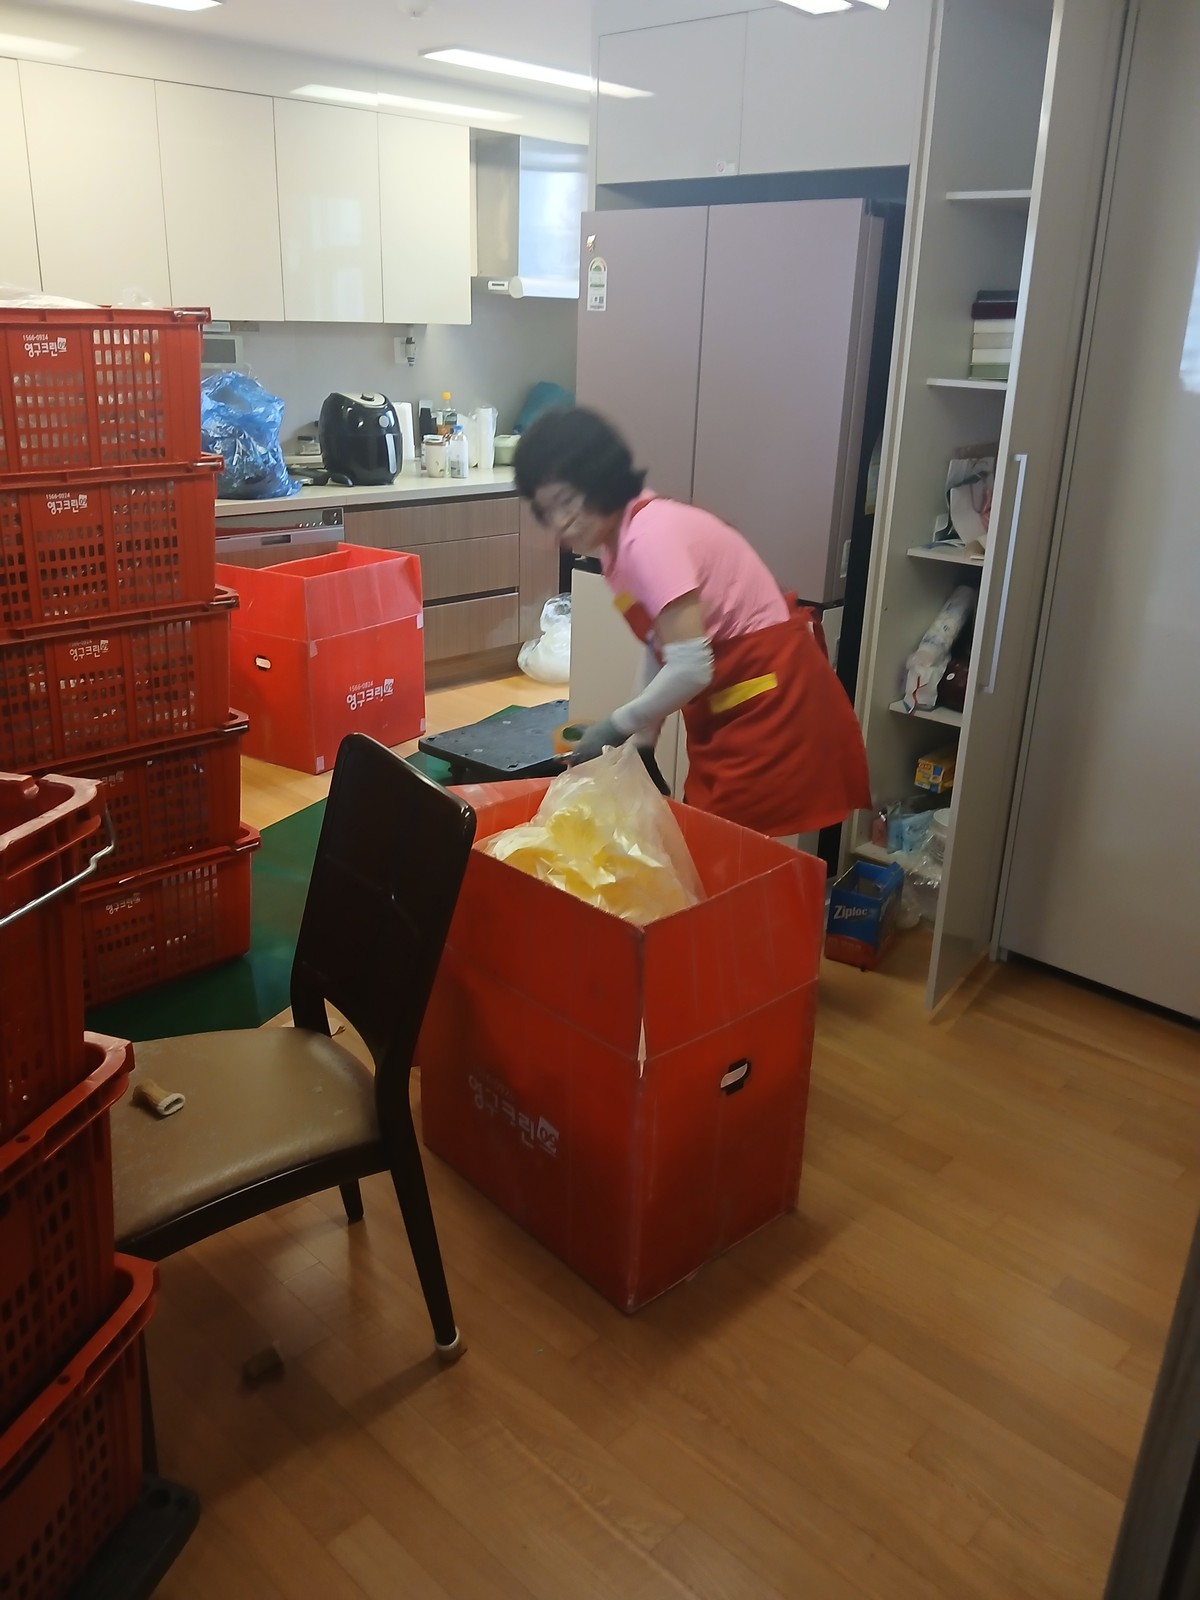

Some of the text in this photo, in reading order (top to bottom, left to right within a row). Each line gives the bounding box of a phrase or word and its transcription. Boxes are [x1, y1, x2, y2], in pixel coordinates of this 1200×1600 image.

[22, 333, 49, 341] 1566-0924
[24, 341, 58, 358] 영구크린
[46, 492, 71, 500] 1566-0924
[47, 500, 79, 515] 영구크린
[69, 644, 100, 661] 영구크린
[346, 685, 383, 711] 영구크린
[833, 904, 868, 920] Ziploc
[468, 1074, 535, 1149] 영구크린
